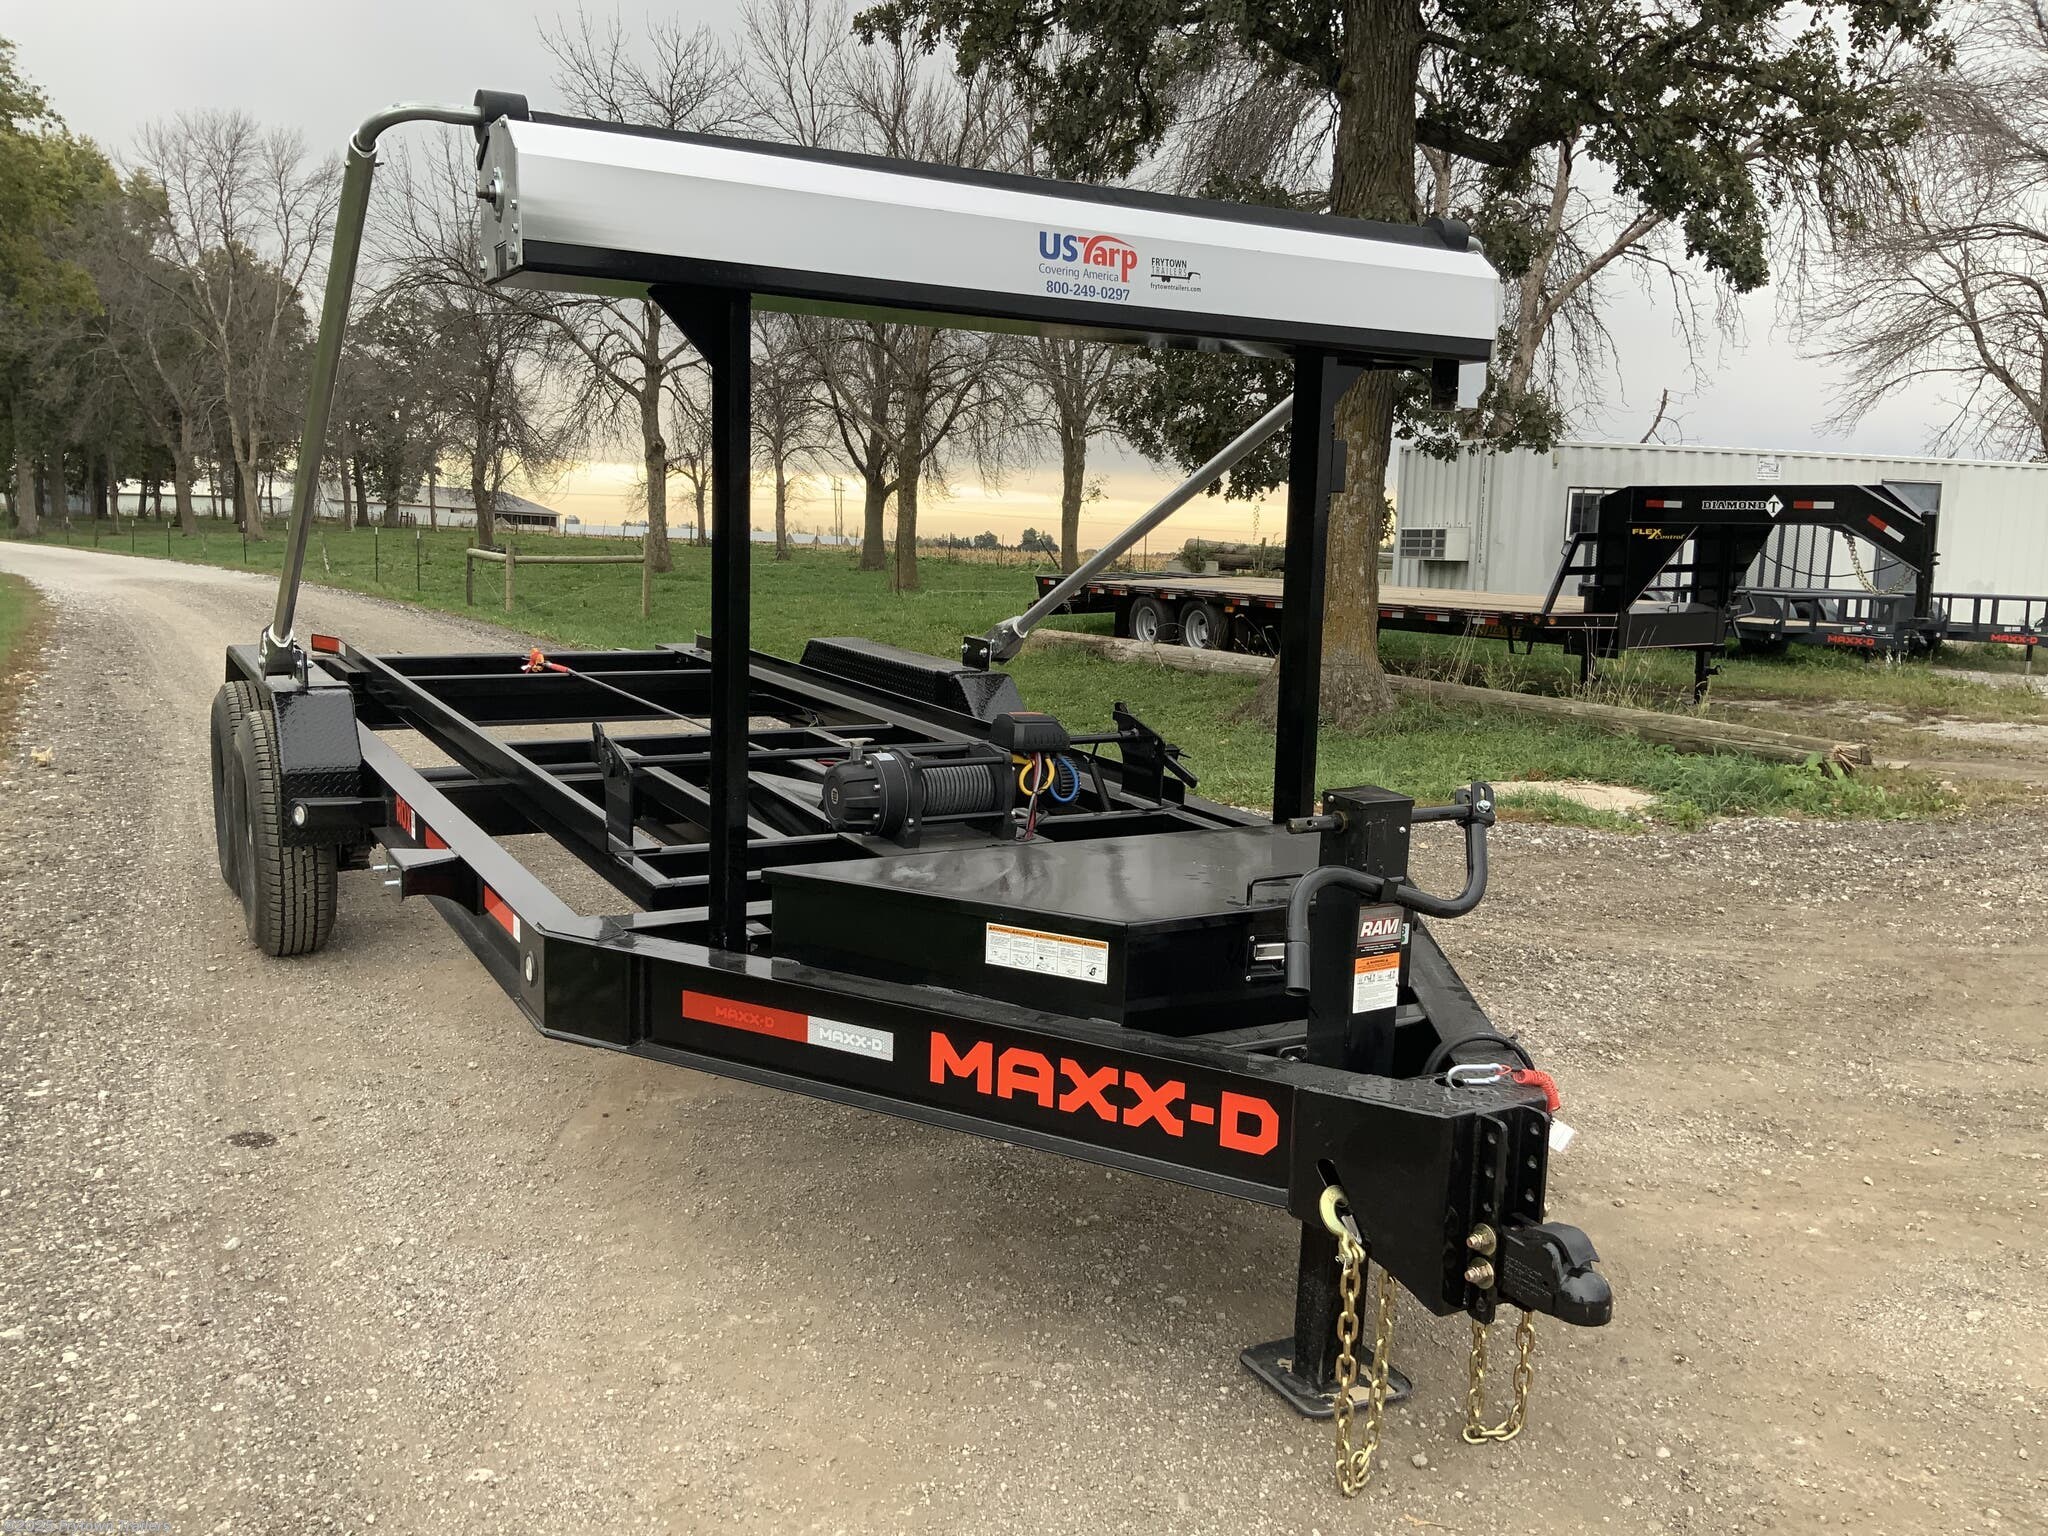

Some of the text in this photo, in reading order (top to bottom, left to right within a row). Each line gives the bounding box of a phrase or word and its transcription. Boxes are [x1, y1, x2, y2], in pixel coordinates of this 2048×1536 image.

[1151, 257, 1187, 269] FRYTOWN
[1151, 265, 1187, 277] TRAILERS
[1038, 263, 1119, 283] Covering America
[1046, 280, 1130, 301] 800-249-0297
[1702, 500, 1767, 511] DIAMOND
[1631, 528, 1662, 540] FLEX
[1827, 634, 1875, 647] MAXX-D
[1990, 633, 2039, 645] MAXX-D
[1359, 918, 1400, 938] RAM
[714, 1006, 775, 1029] MAXX-D
[819, 1027, 883, 1052] MAXX-D
[929, 1031, 1280, 1157] MAXX-D
